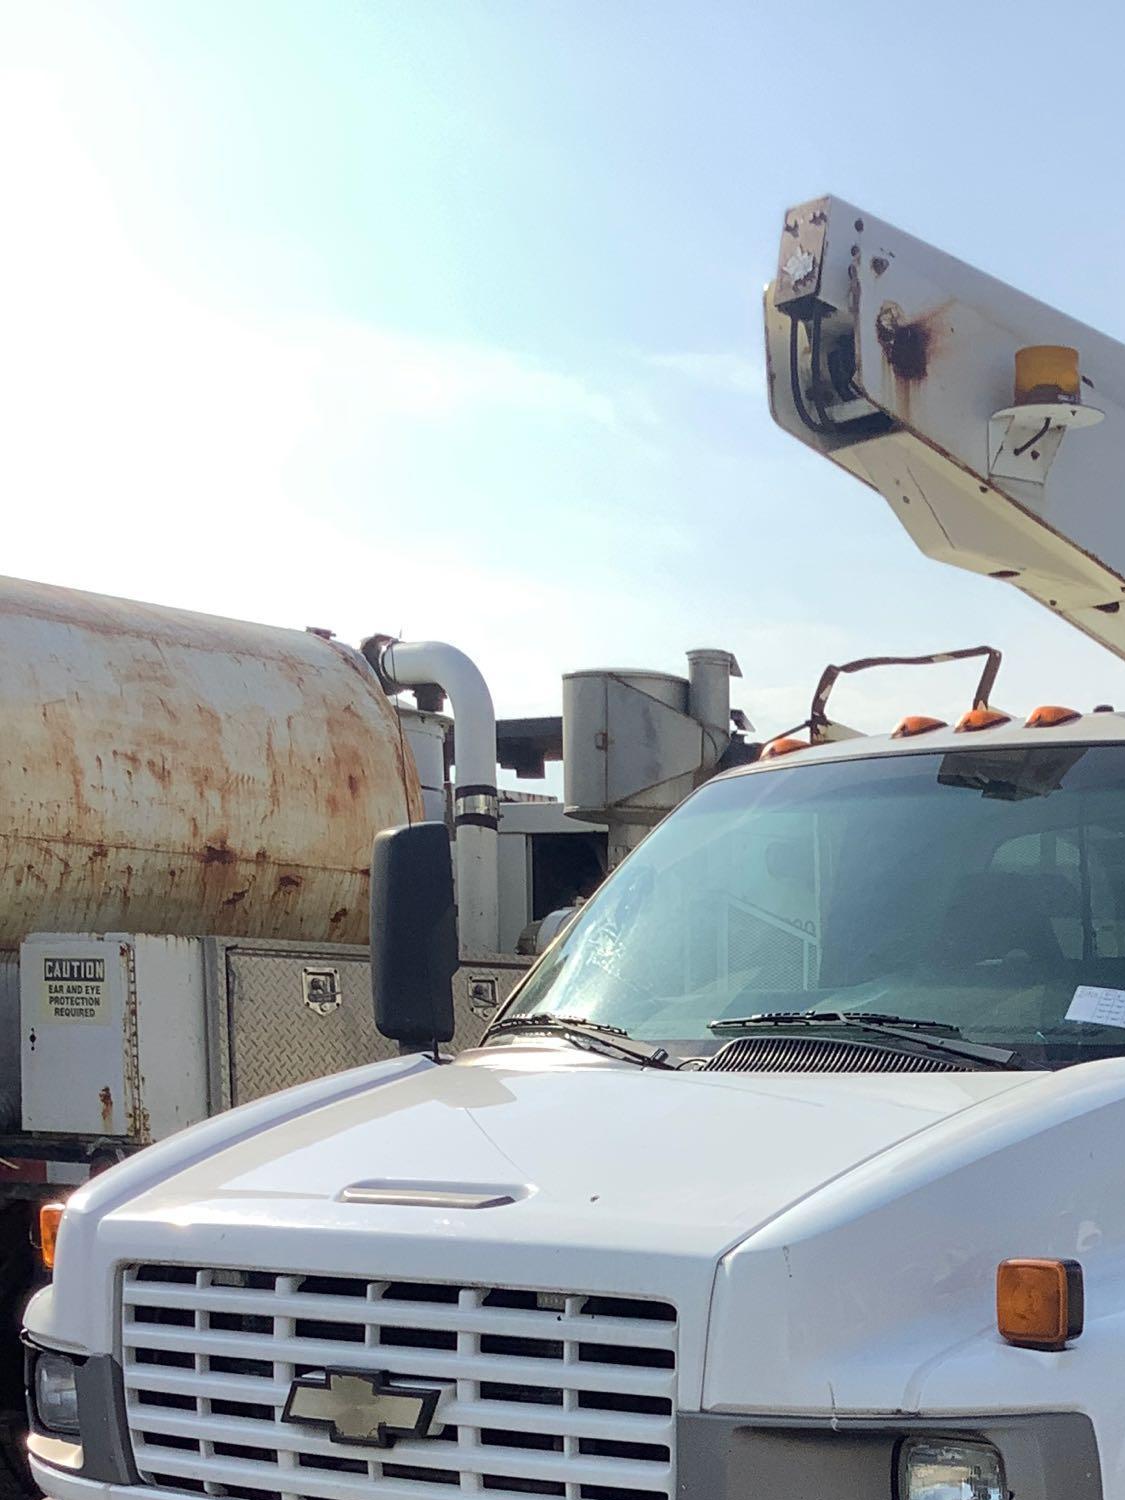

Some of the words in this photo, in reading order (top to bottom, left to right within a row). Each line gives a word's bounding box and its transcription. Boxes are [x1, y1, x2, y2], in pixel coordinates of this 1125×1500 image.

[45, 961, 104, 979] CAUTION
[48, 984, 64, 994] EAR
[66, 984, 83, 995] AND
[85, 985, 101, 995] EYE
[48, 995, 101, 1006] PROTECTION
[54, 1007, 96, 1018] REQUIRED
